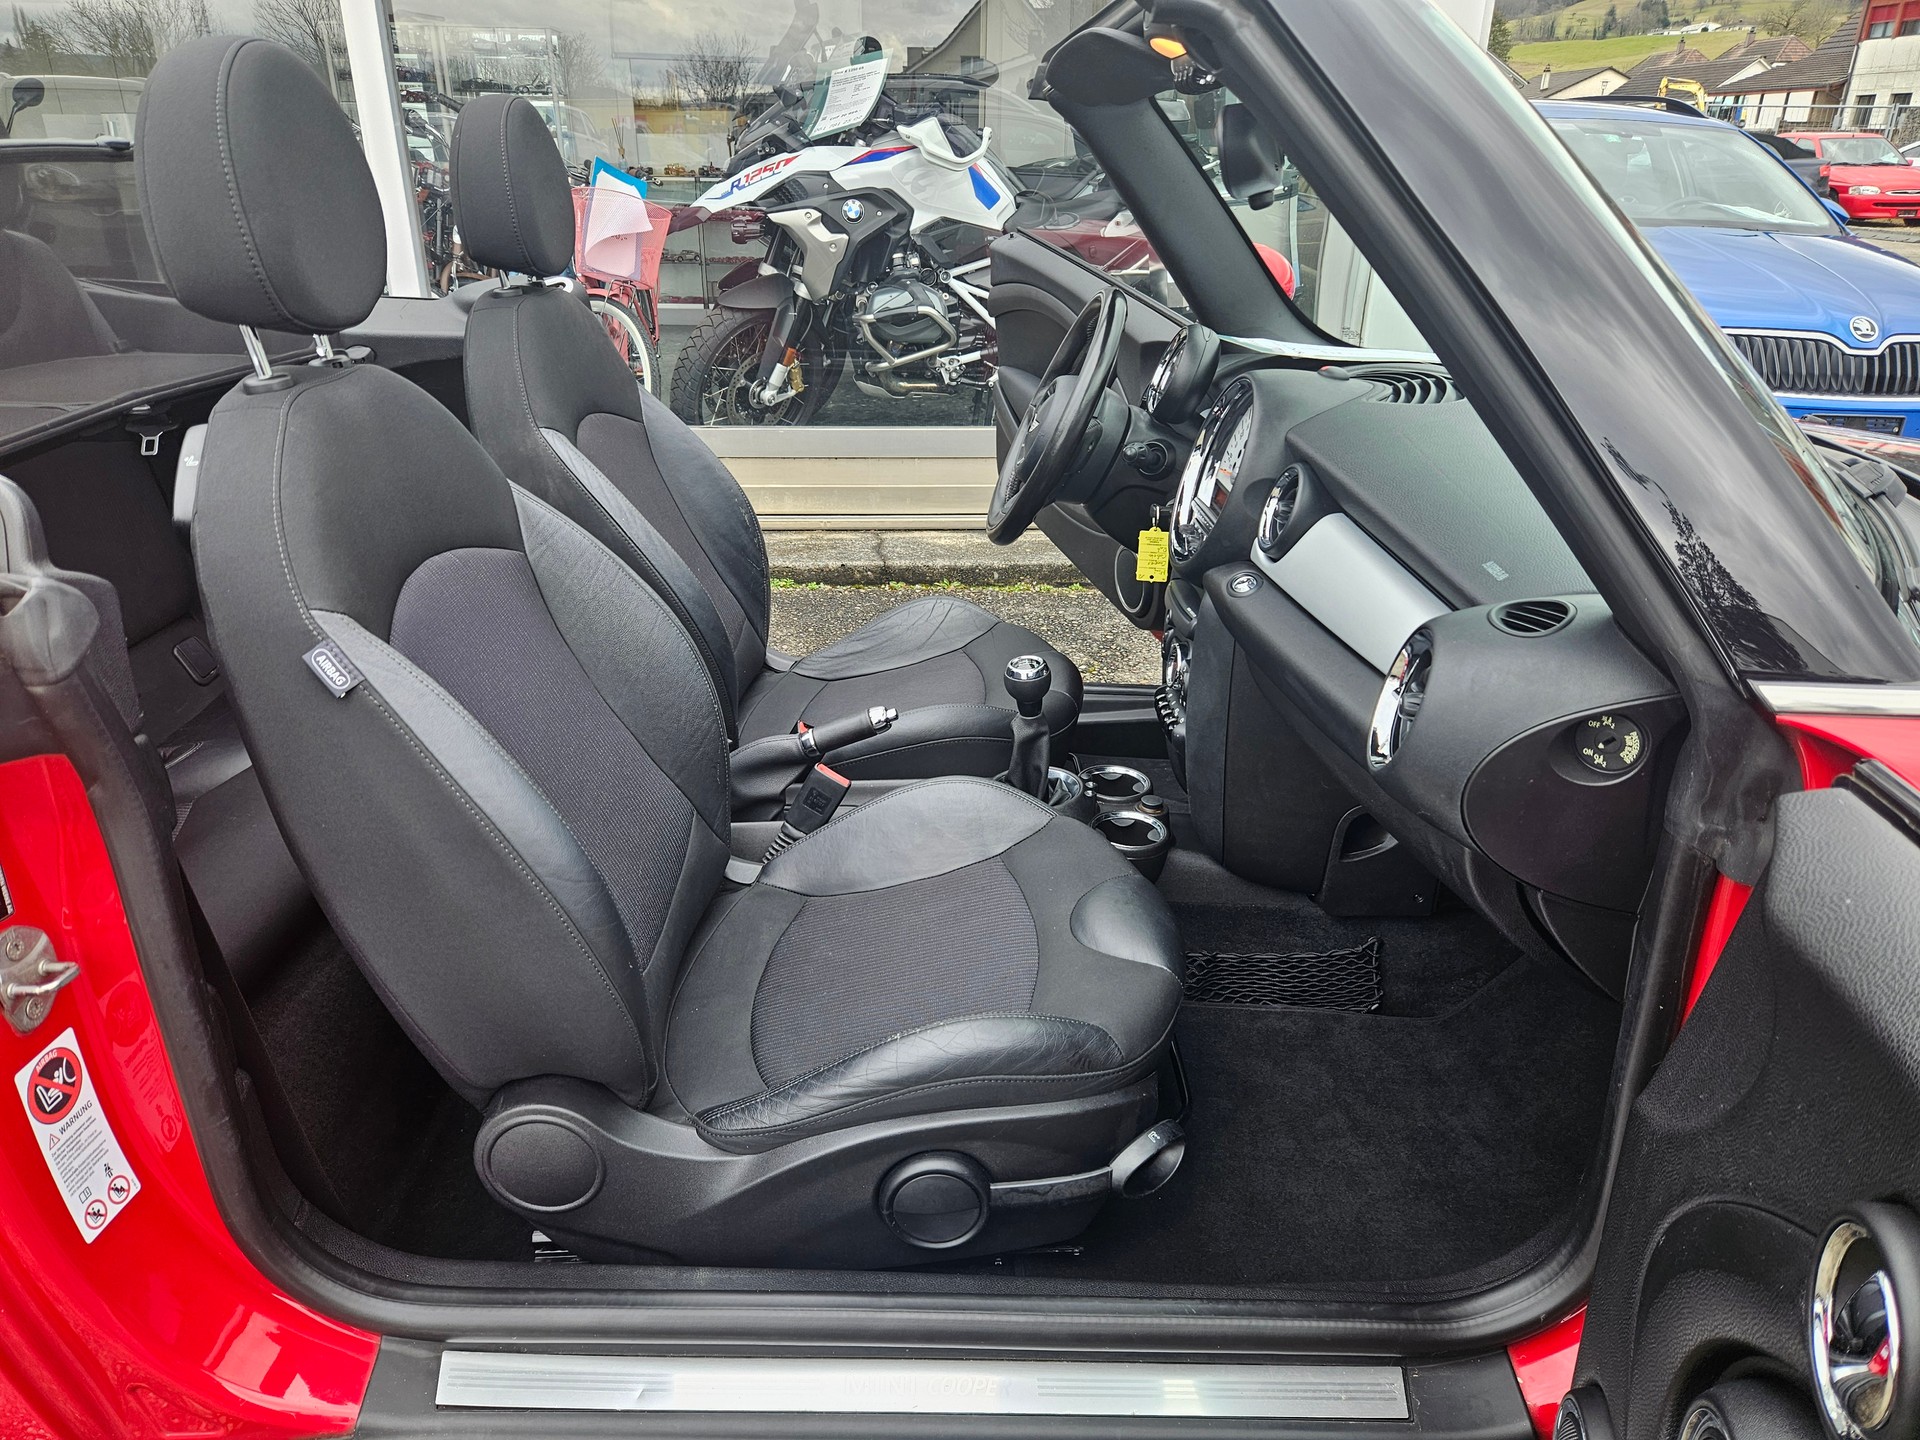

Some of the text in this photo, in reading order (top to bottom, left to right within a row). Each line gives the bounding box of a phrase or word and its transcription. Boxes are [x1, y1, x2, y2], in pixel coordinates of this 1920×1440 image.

[316, 654, 347, 686] AIRBAG
[1588, 720, 1600, 728] OFF
[1582, 747, 1594, 757] ON
[35, 1049, 58, 1073] AIRBAG
[58, 1100, 93, 1135] WARNUNG
[842, 1374, 918, 1397] MINI
